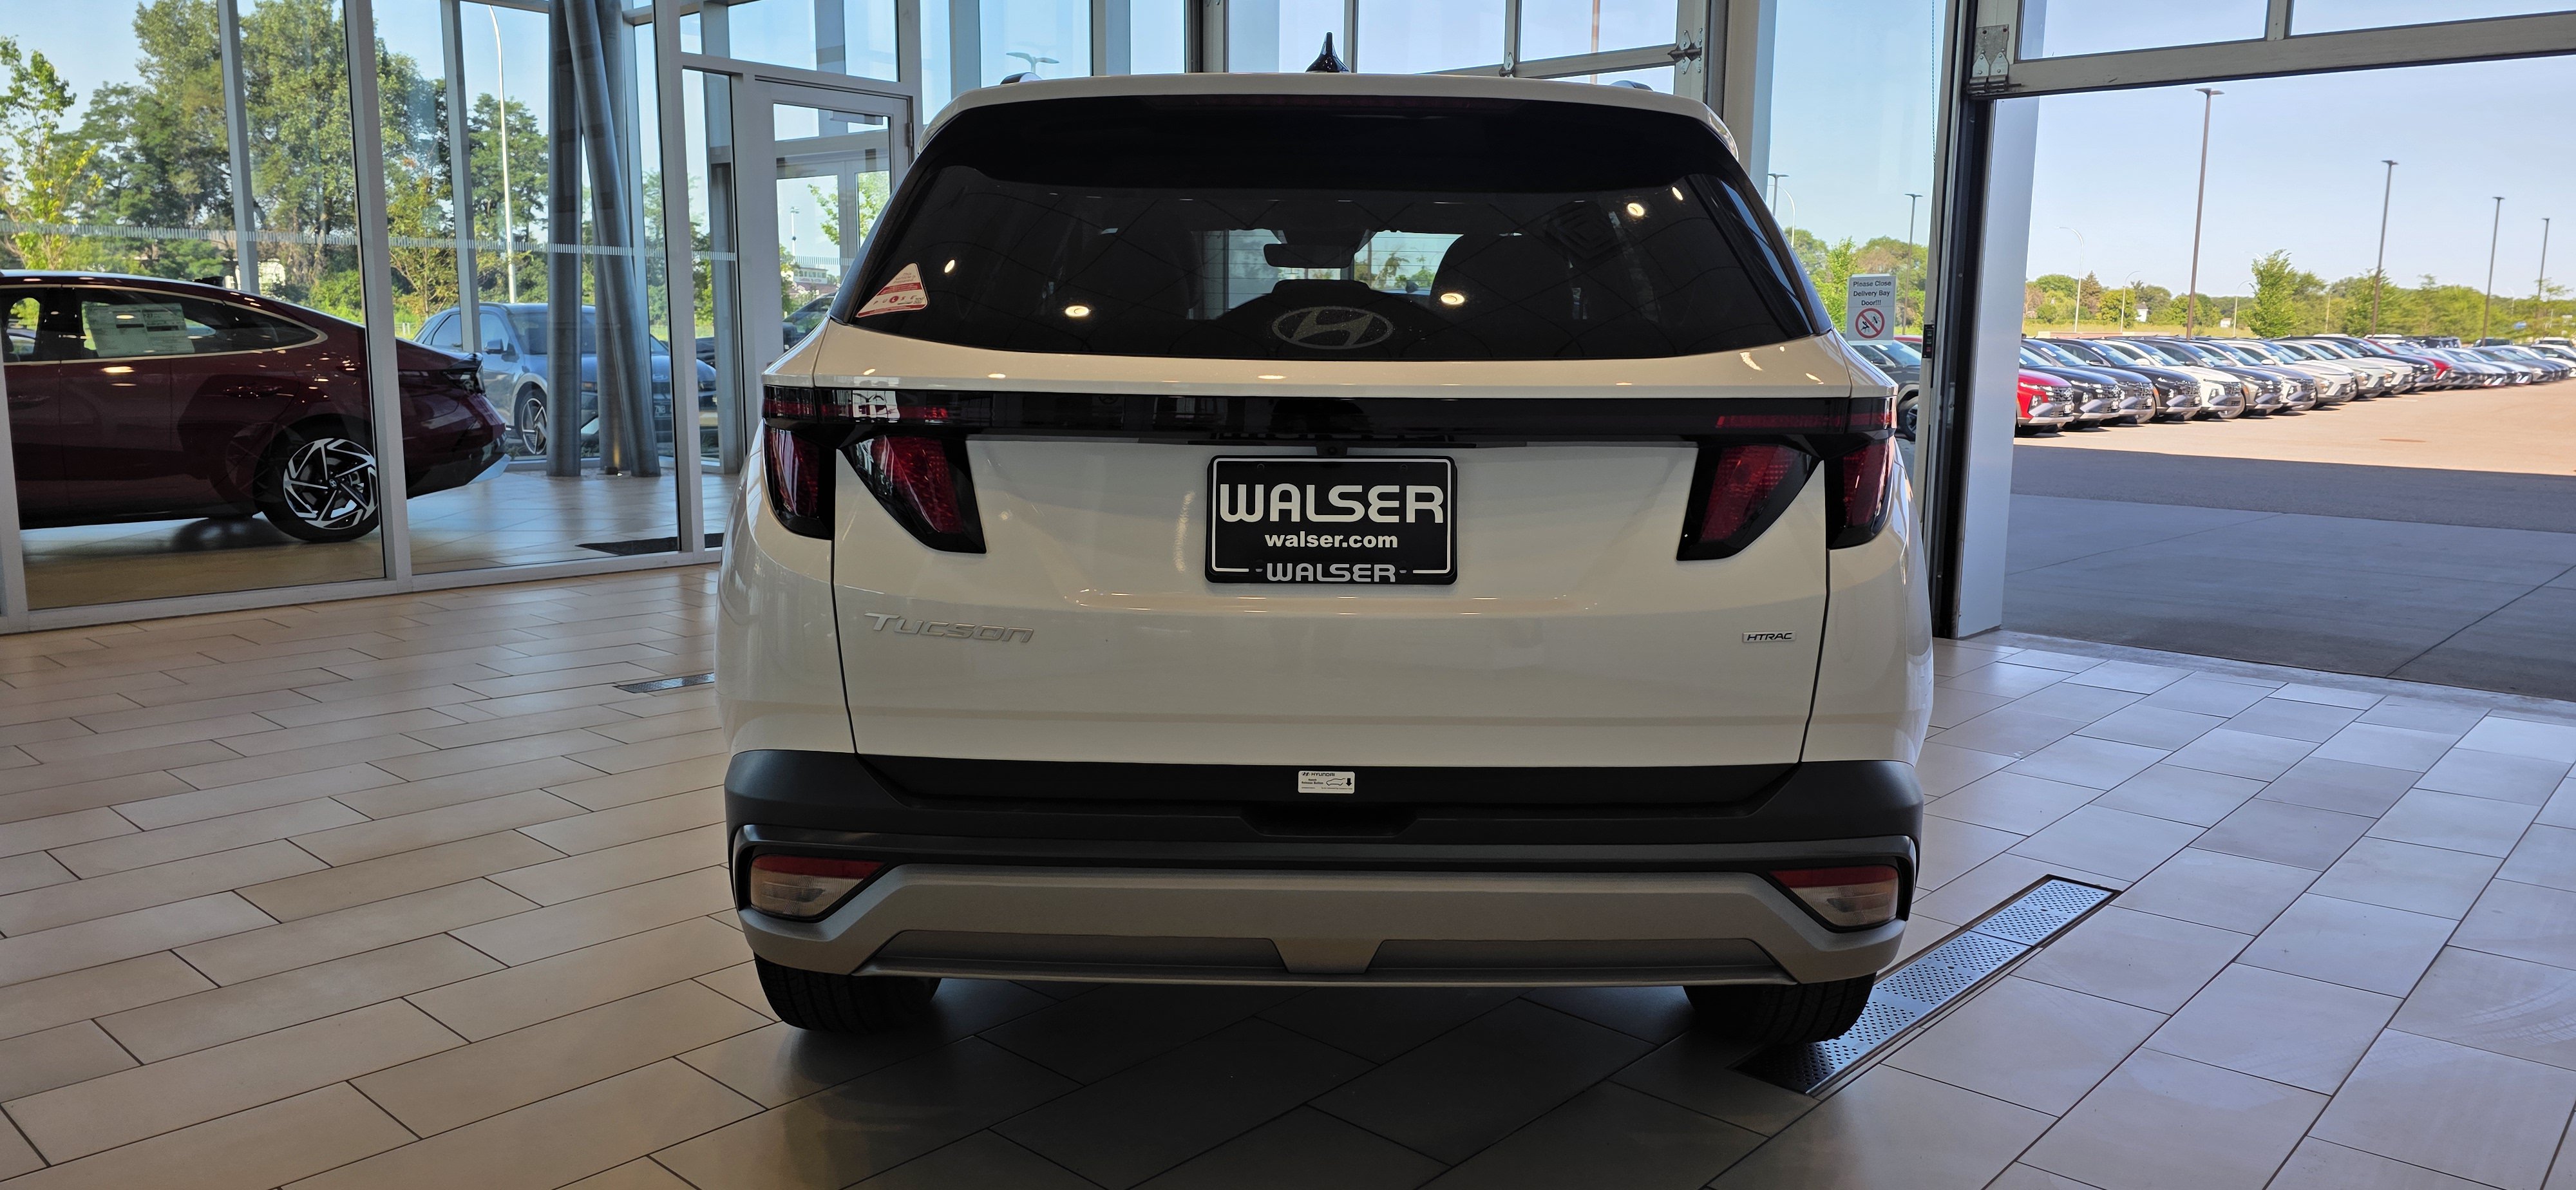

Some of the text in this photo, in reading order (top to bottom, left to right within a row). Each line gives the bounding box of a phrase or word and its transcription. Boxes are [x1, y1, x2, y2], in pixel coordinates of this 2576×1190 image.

[1220, 483, 1444, 524] WALSER
[1264, 531, 1398, 548] walser.com
[1266, 562, 1396, 582] WALSER
[1747, 632, 1793, 641] HTRAC
